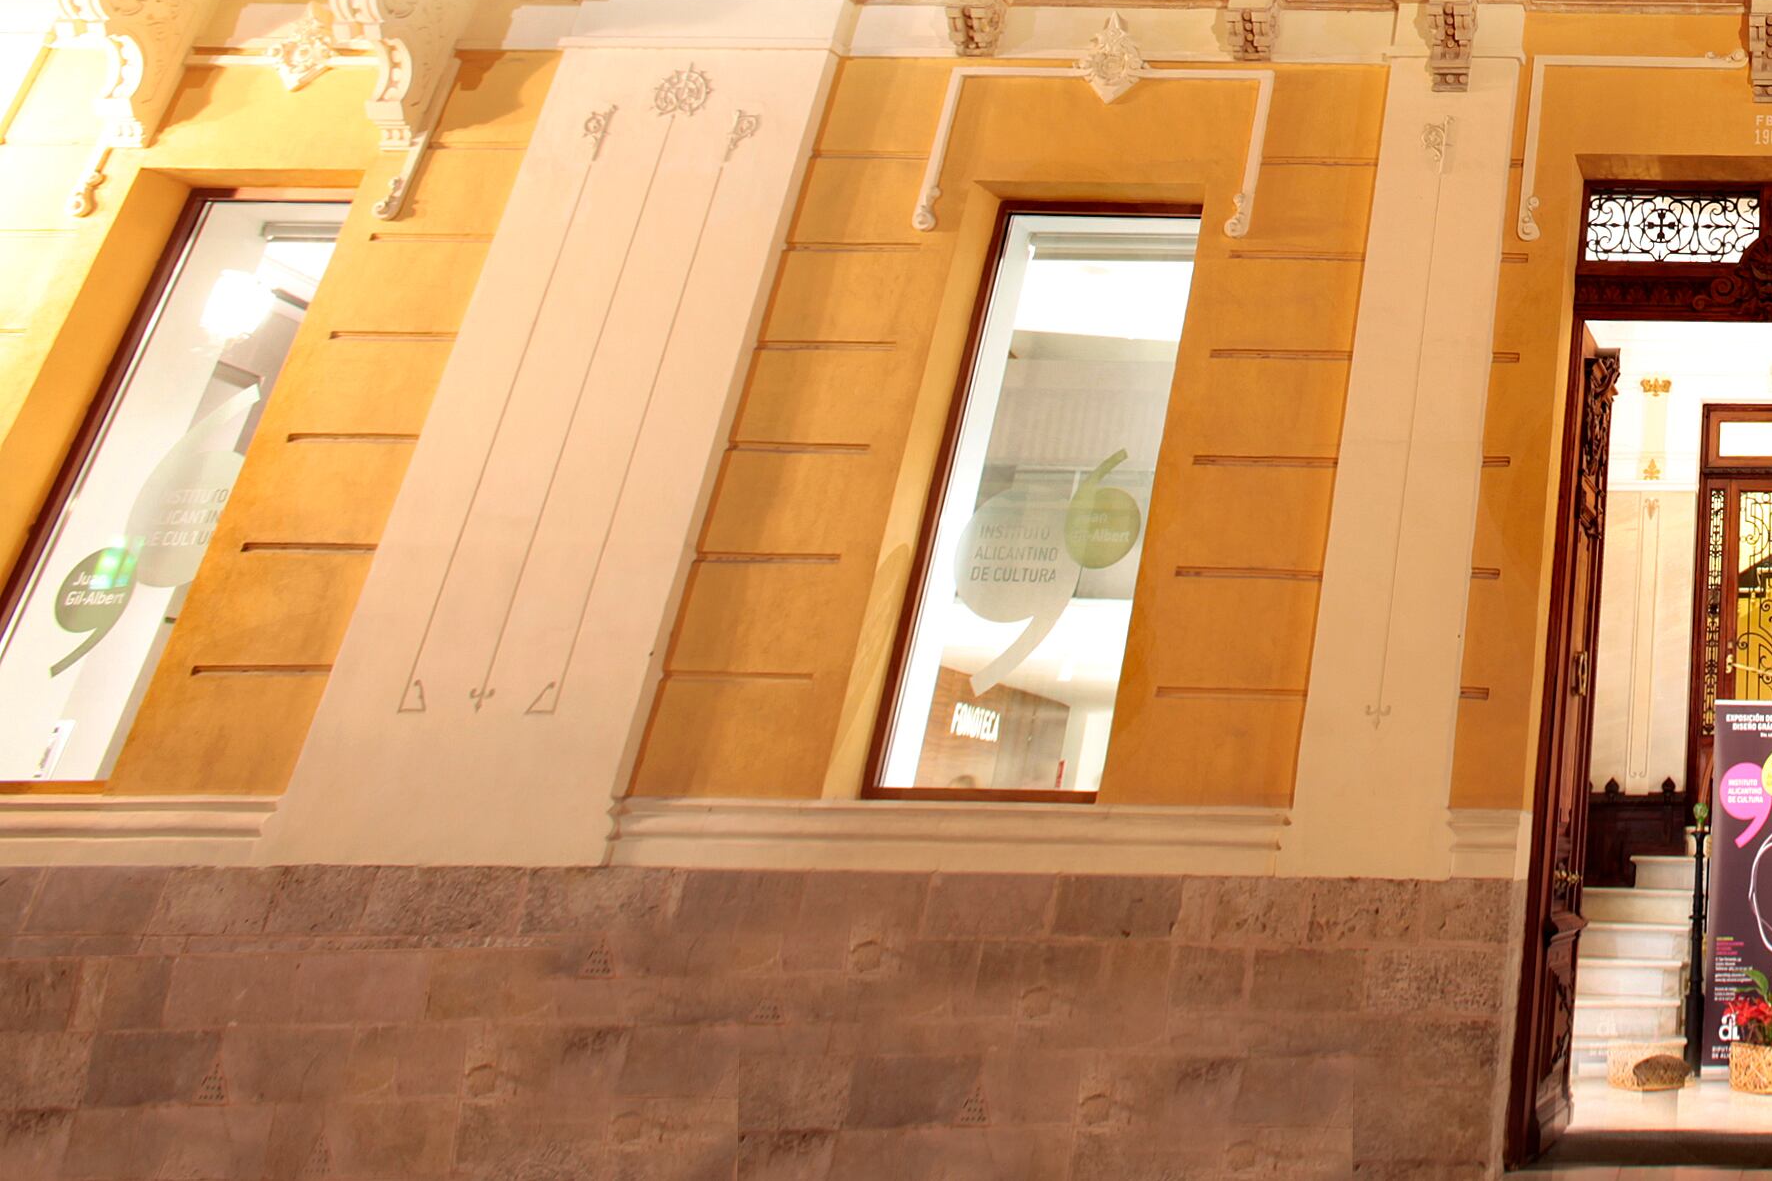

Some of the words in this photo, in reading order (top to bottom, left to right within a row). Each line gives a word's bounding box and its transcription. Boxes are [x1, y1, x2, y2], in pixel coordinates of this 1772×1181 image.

[162, 530, 210, 547] CULTU
[979, 523, 1050, 540] INSTITUTO
[974, 545, 1058, 562] ALICANTINO
[970, 565, 990, 582] DE
[993, 565, 1057, 583] CULTURA
[64, 590, 126, 606] Gil-Albert
[950, 702, 1001, 743] FONOTECA
[1732, 722, 1757, 731] DISEÑO
[1728, 778, 1758, 786] INSTITUTO
[1728, 787, 1763, 795] ALICANTINO
[1728, 795, 1736, 804] DE
[1736, 795, 1764, 804] CULTURA
